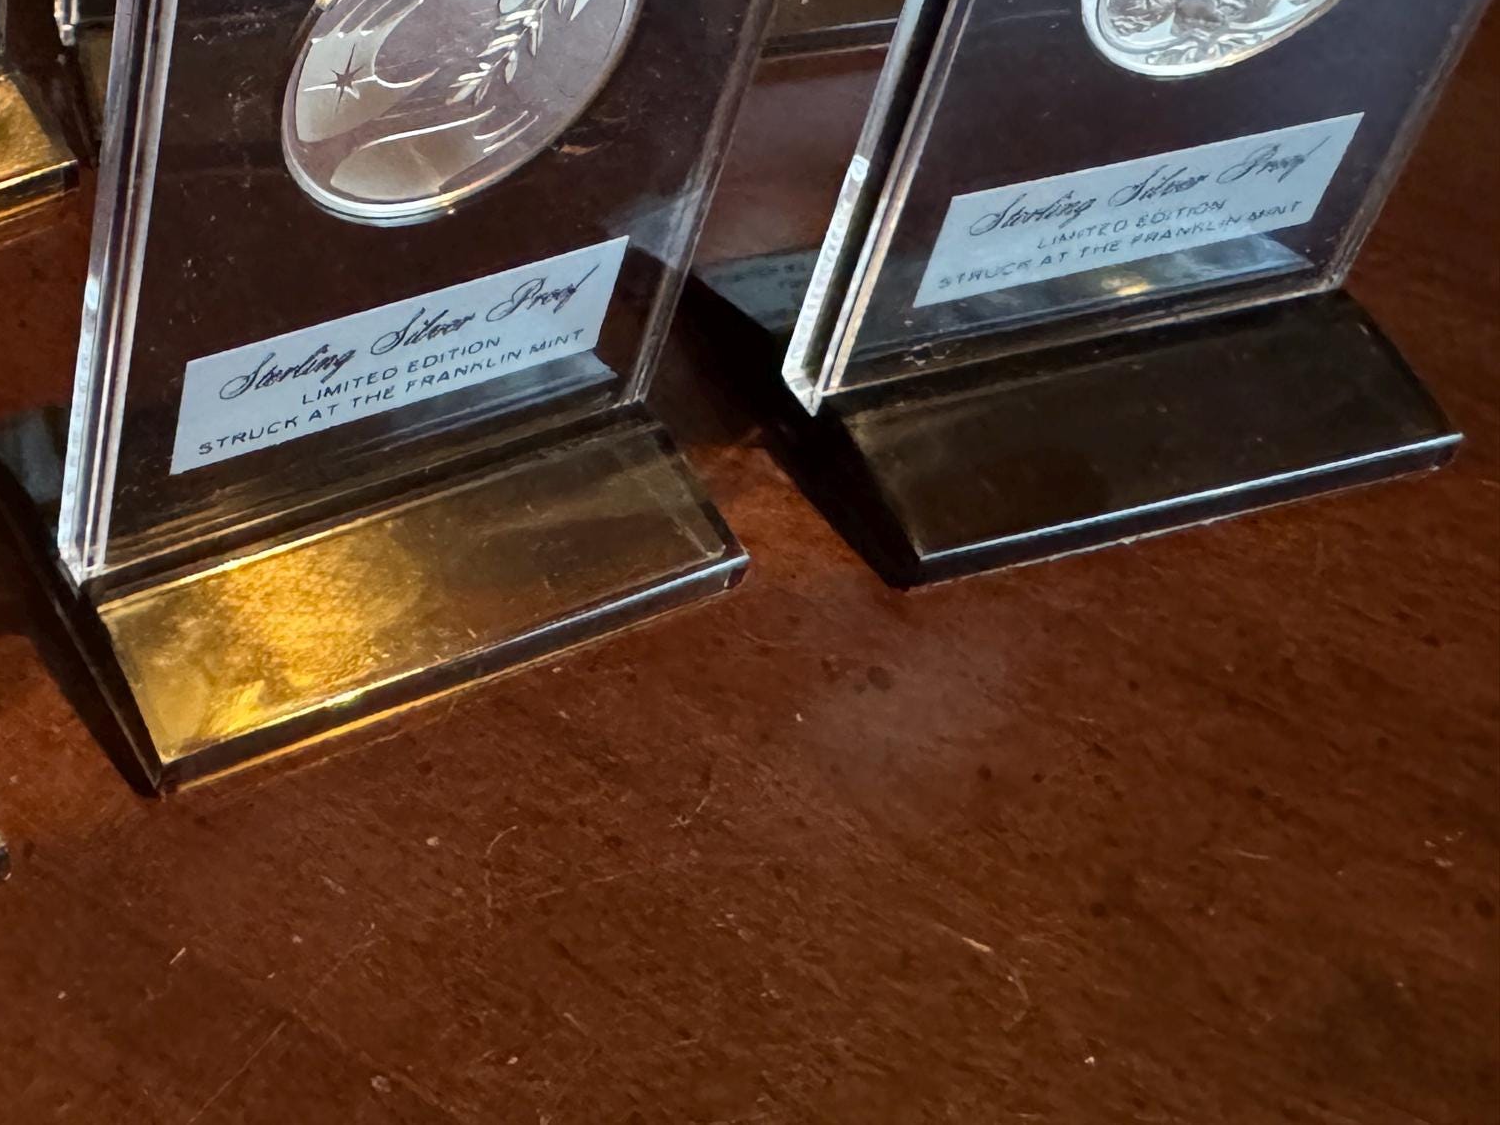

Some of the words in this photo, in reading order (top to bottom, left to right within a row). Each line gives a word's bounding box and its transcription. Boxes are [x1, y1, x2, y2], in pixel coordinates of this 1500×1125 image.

[968, 189, 1098, 237] Sterling
[1107, 163, 1210, 208] Silver
[1215, 134, 1333, 185] Proof
[1037, 218, 1128, 250] LIMITED
[1135, 198, 1228, 228] EDITION
[937, 258, 1033, 290] STRUCK
[1040, 251, 1070, 266] AT
[1079, 239, 1123, 259] THE
[1130, 214, 1242, 247] FRANKLIN
[1248, 200, 1303, 221] MINT
[218, 345, 357, 401] Sterling
[369, 307, 477, 357] Silver
[485, 263, 600, 324] Proof
[300, 365, 400, 406] LIMITED
[407, 335, 503, 375] EDITION
[197, 414, 300, 456] STRUCK
[306, 402, 341, 423] AT
[350, 386, 397, 410] THE
[405, 346, 523, 396] FRANKLIN
[528, 327, 587, 355] MINT
